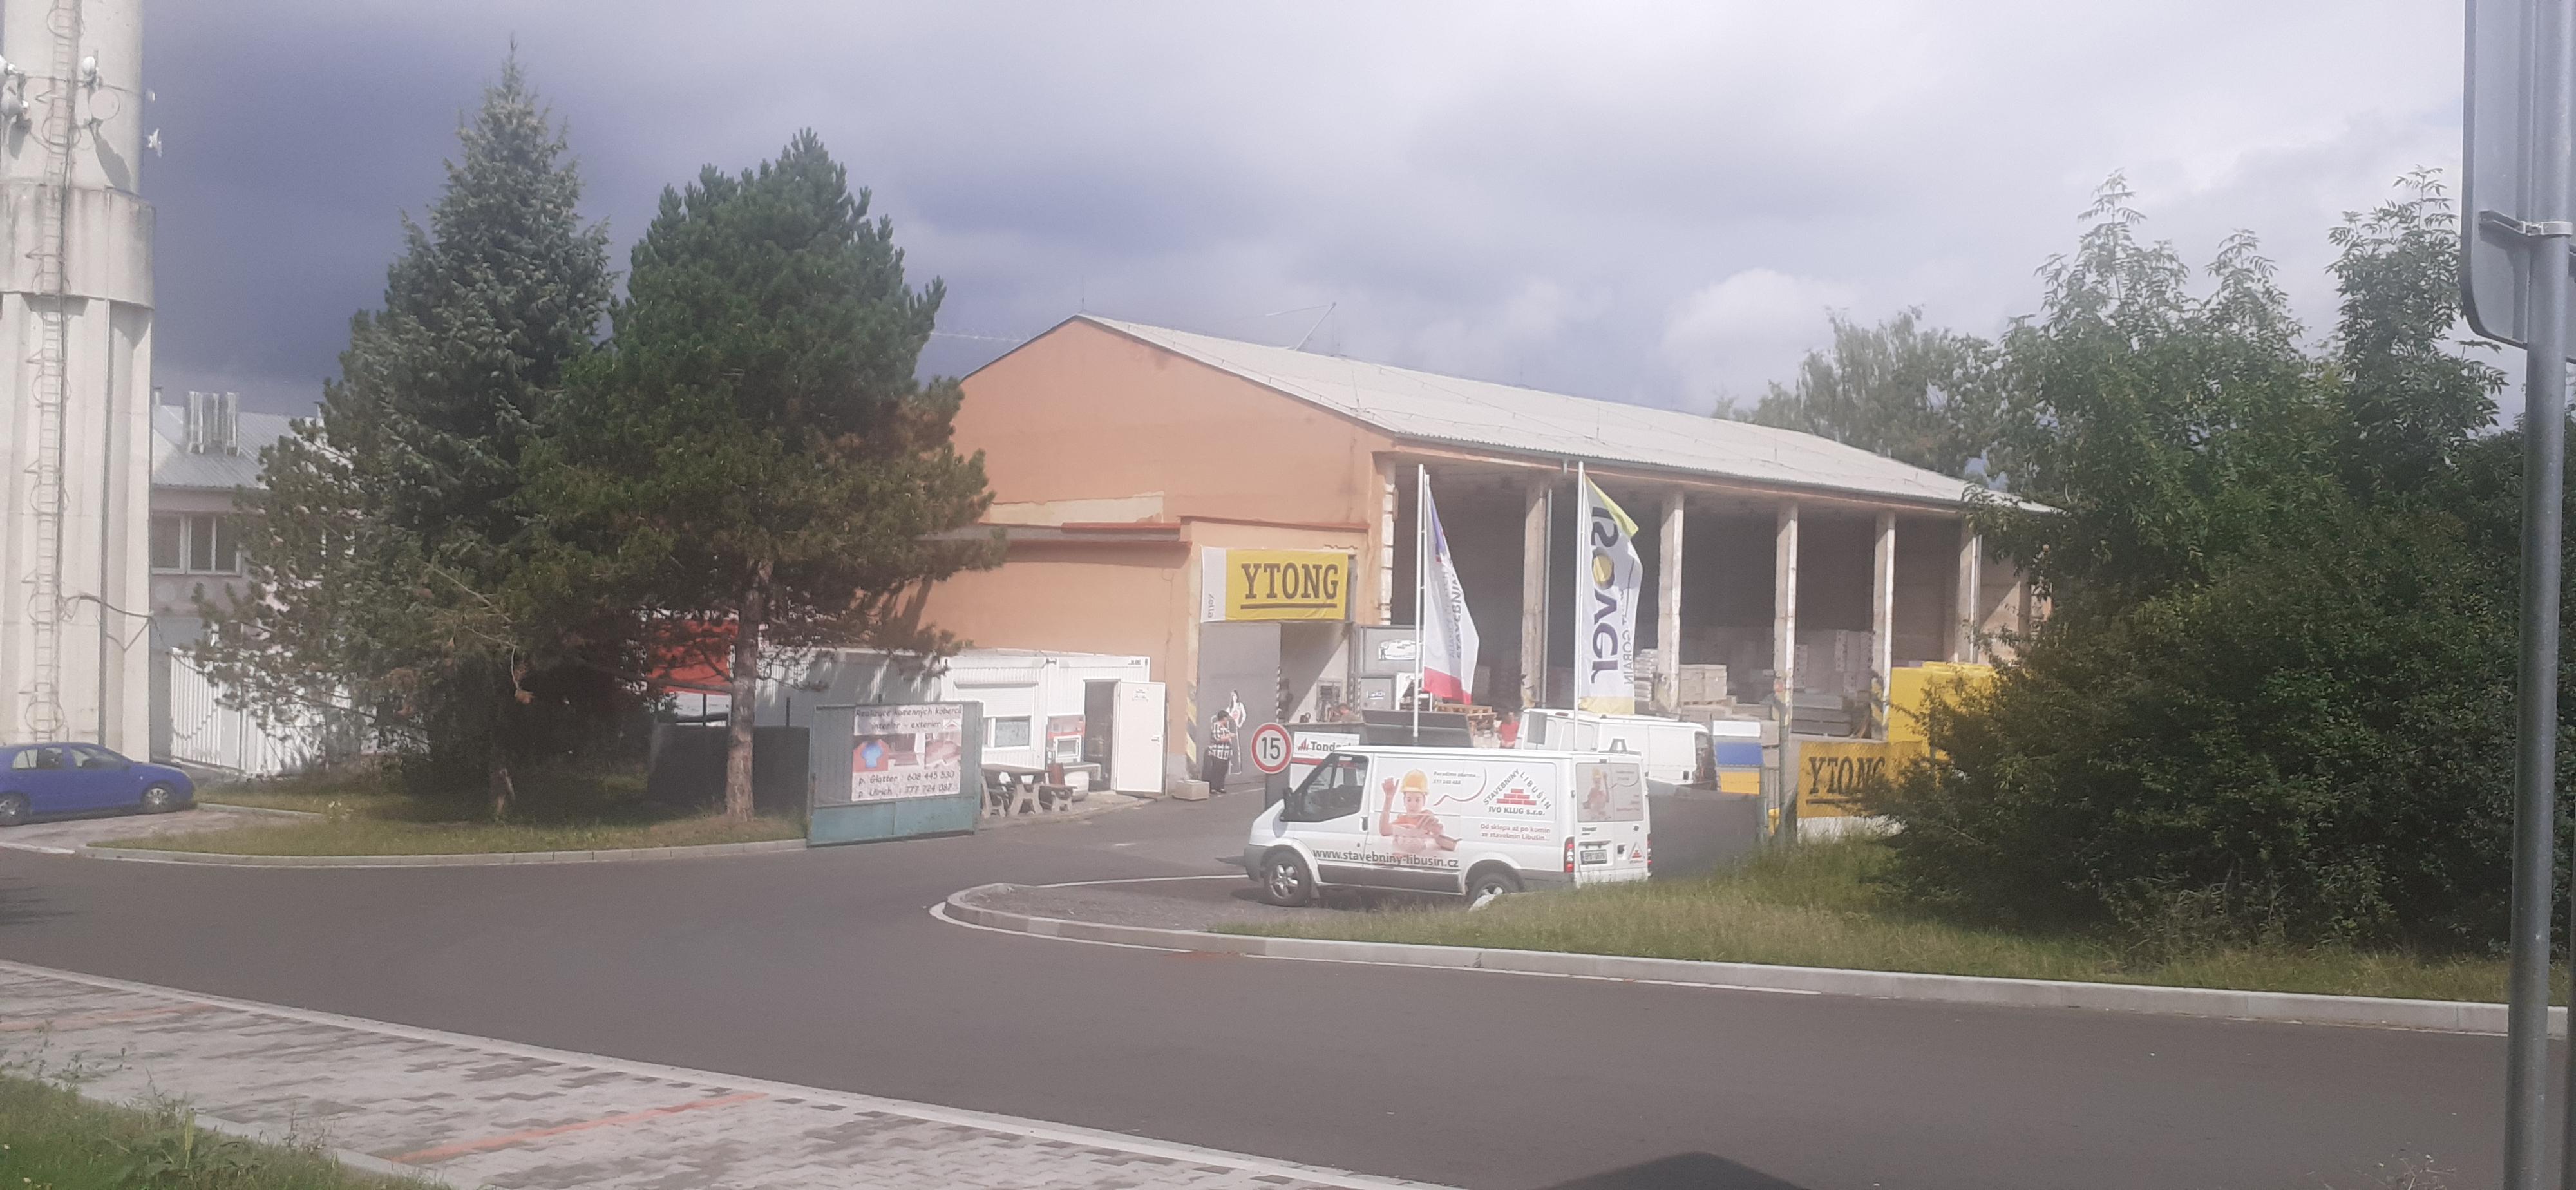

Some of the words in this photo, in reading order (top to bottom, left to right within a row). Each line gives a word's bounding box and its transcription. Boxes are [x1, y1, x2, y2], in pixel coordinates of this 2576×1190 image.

[1241, 562, 1339, 600] YTONG
[1262, 737, 1281, 760] 15
[1311, 741, 1351, 753] Tond
[1483, 768, 1519, 805] STAVEBNINY
[1312, 848, 1459, 868] www.stavebniny-libusin.cz
